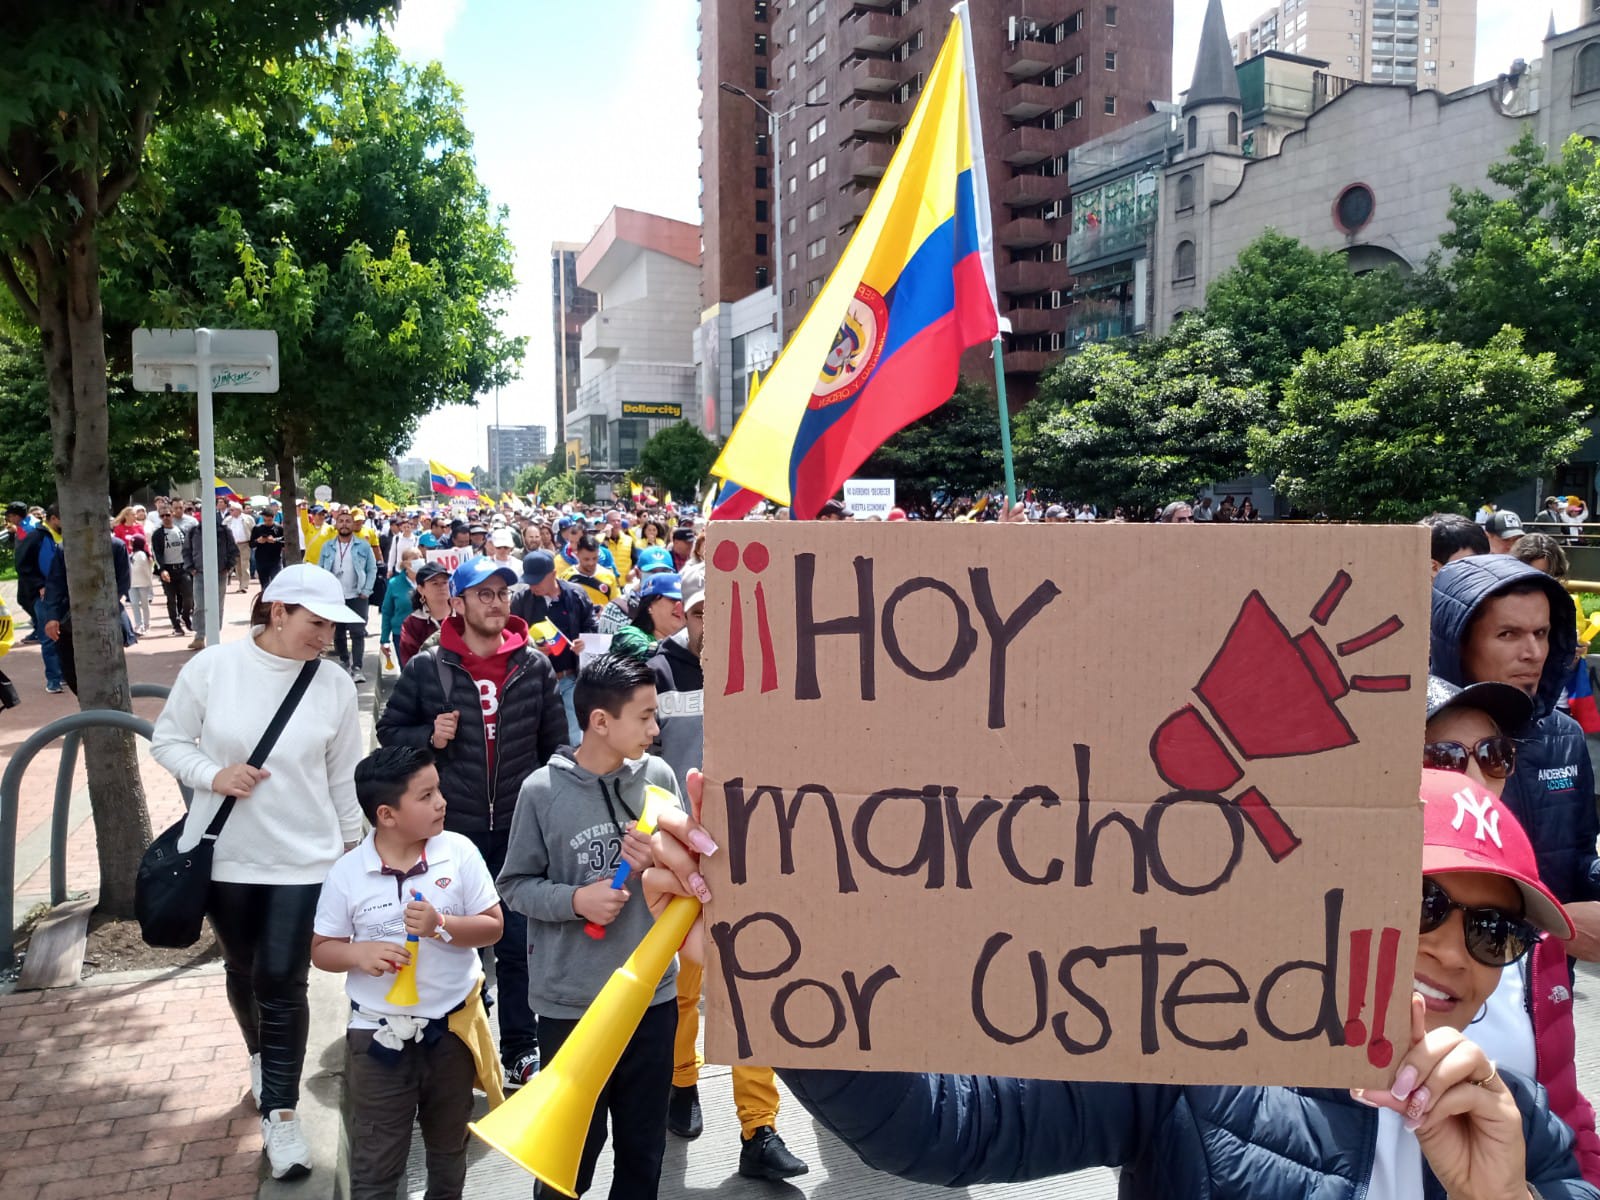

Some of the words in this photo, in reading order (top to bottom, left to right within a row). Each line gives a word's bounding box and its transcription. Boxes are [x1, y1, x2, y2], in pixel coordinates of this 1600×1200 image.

[623, 404, 680, 417] Dollarcity
[1537, 764, 1578, 781] ANDERSON
[1546, 777, 1574, 790] ACOSTA
[722, 743, 1245, 897] marcho
